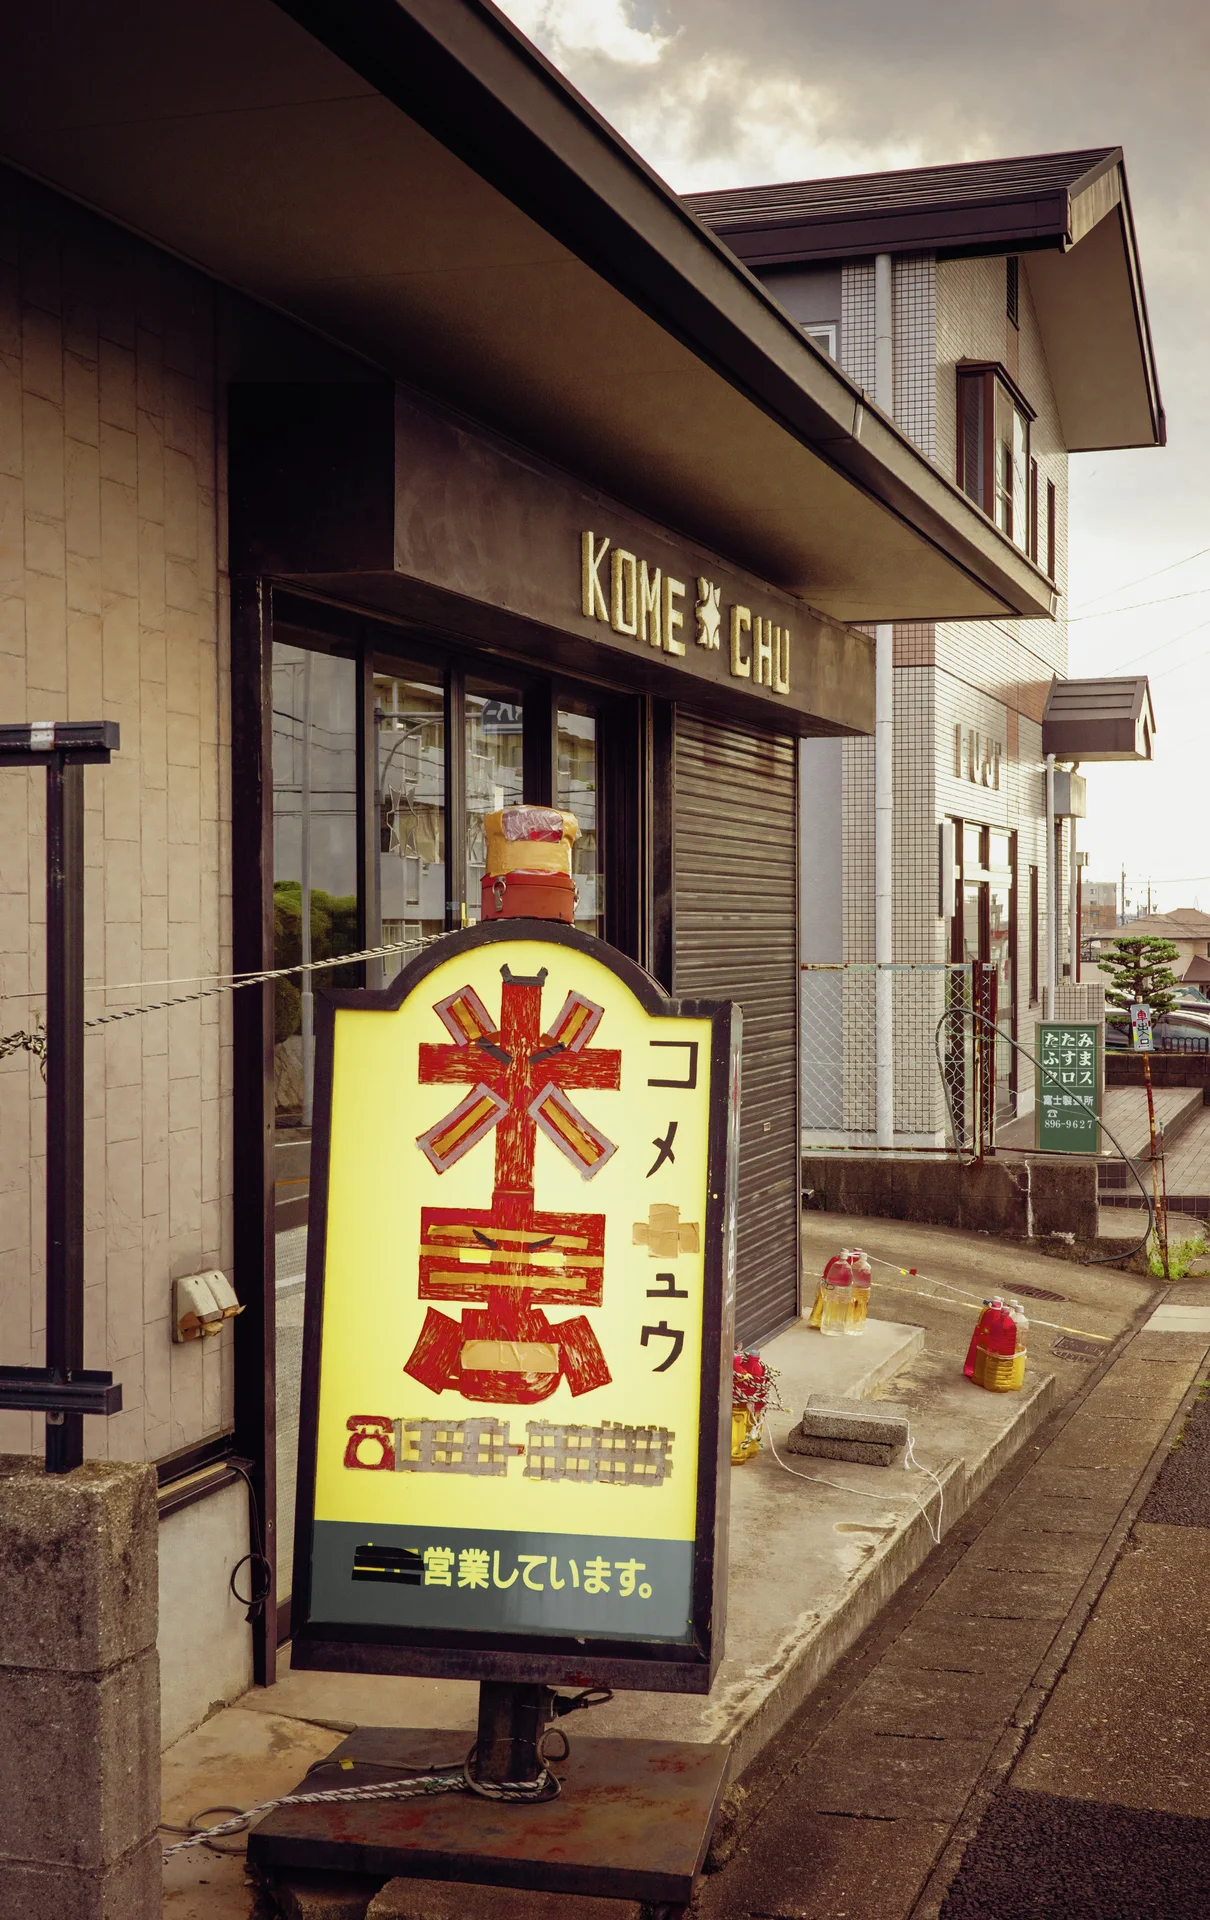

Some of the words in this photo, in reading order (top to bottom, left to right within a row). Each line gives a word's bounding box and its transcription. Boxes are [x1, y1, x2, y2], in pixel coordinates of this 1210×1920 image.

[581, 530, 686, 657] KOME
[730, 603, 790, 695] CHU
[1044, 1032, 1094, 1048] たたみ
[1043, 1051, 1092, 1067] ふすま
[1044, 1119, 1093, 1129] 896-9627
[632, 1040, 700, 1373] コメュウ
[351, 1543, 653, 1599] 営業しています。
